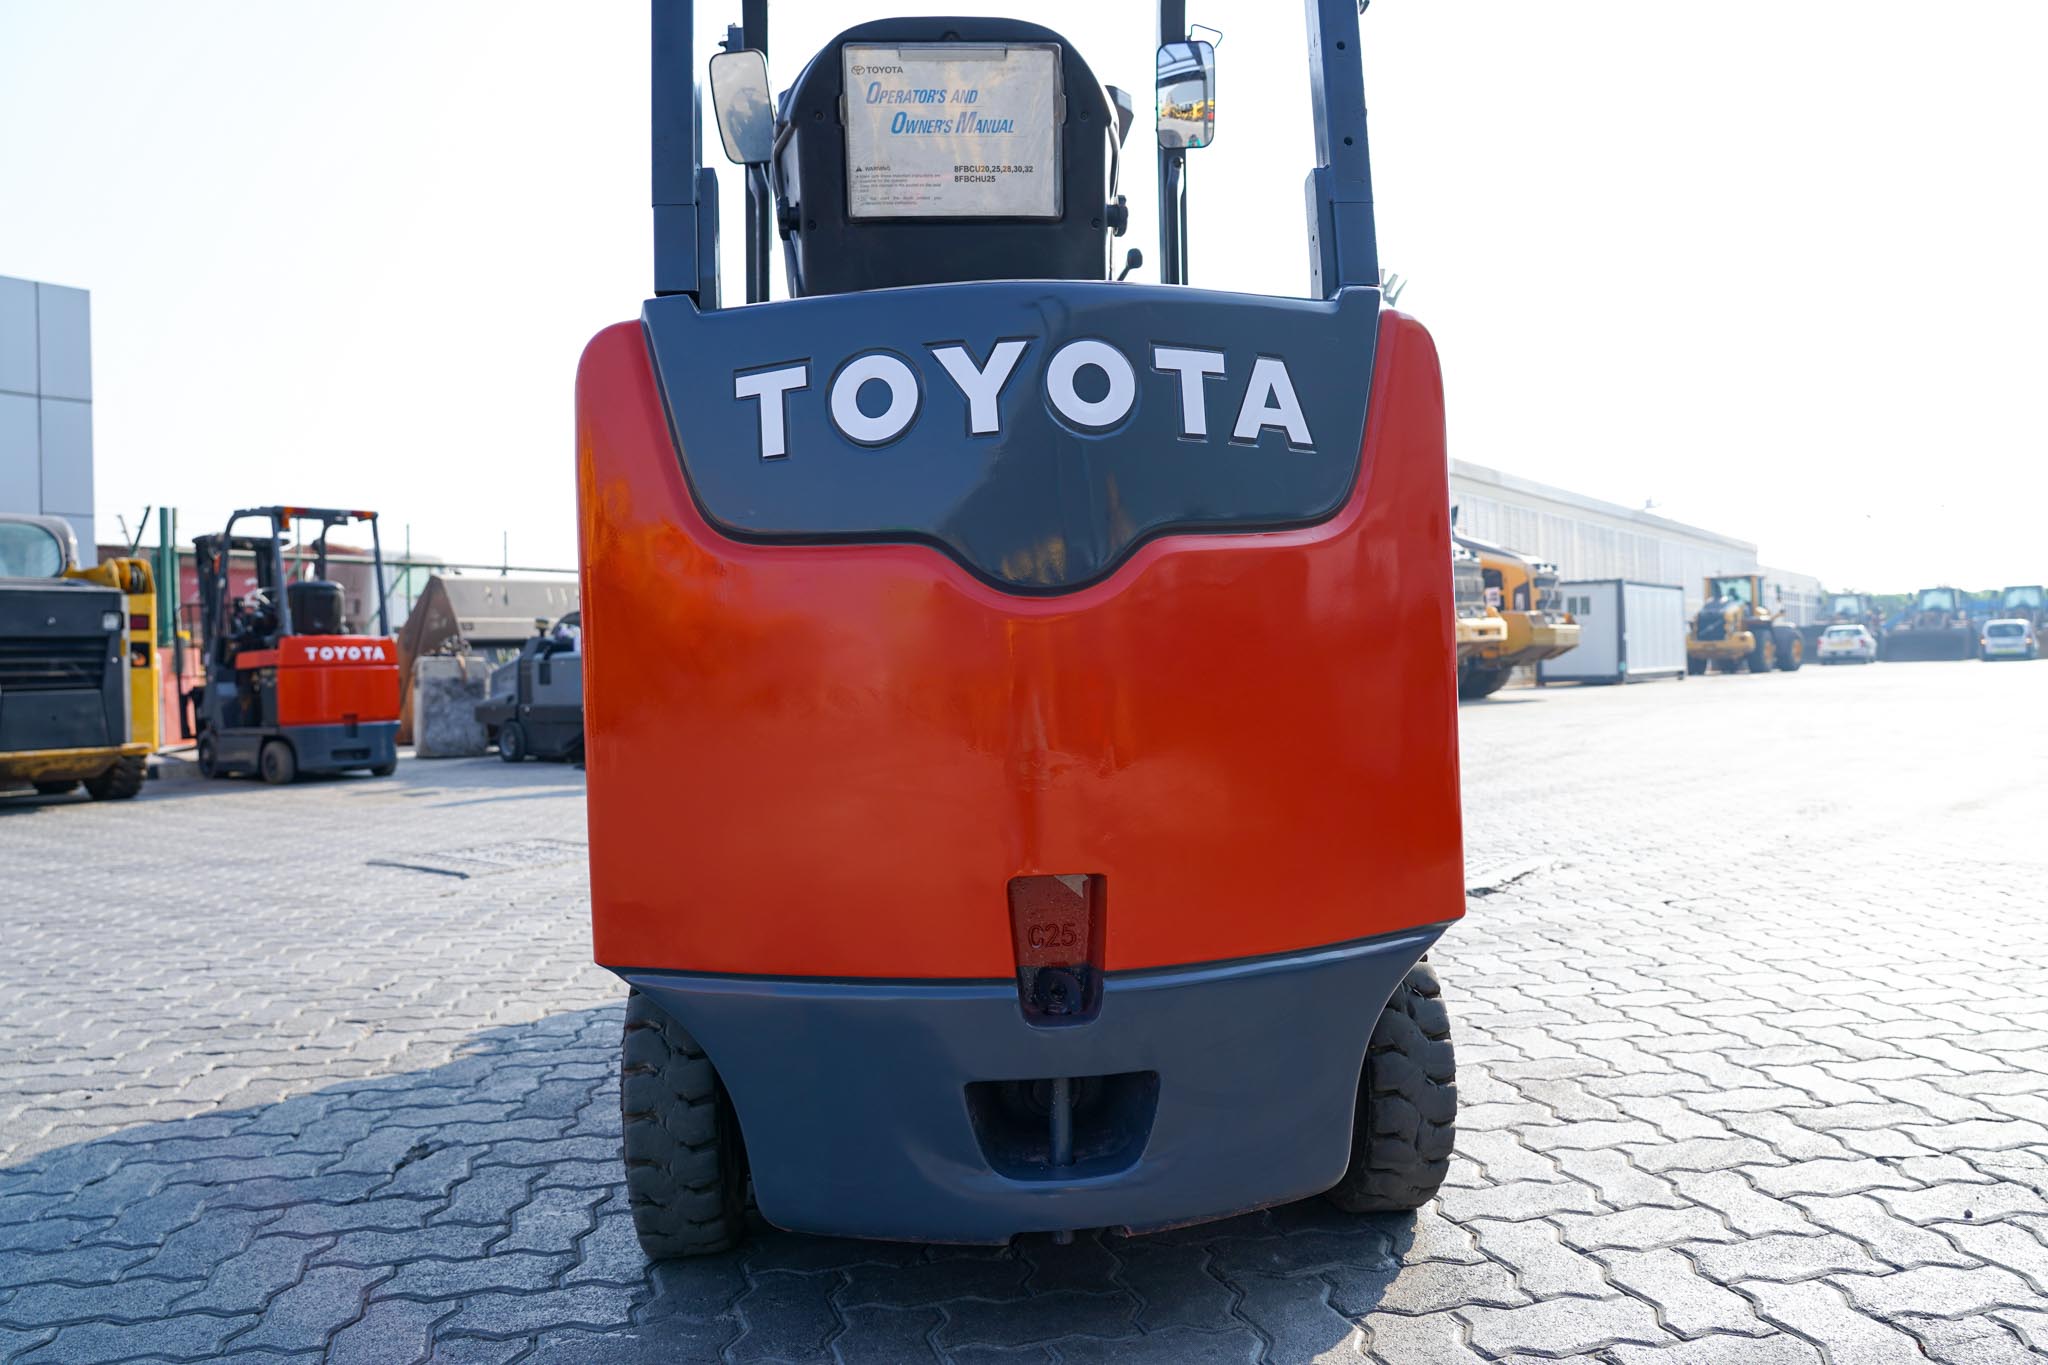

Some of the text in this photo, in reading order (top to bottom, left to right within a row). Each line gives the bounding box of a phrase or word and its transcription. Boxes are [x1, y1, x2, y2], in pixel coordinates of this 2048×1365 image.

[867, 66, 903, 74] TOYOTA
[866, 81, 978, 104] OPERATOR'S AND
[891, 111, 1015, 134] OWNER'S MANUAL
[734, 340, 1315, 459] TOYOTA
[304, 646, 385, 662] TOYOTA
[1028, 923, 1077, 949] C25
